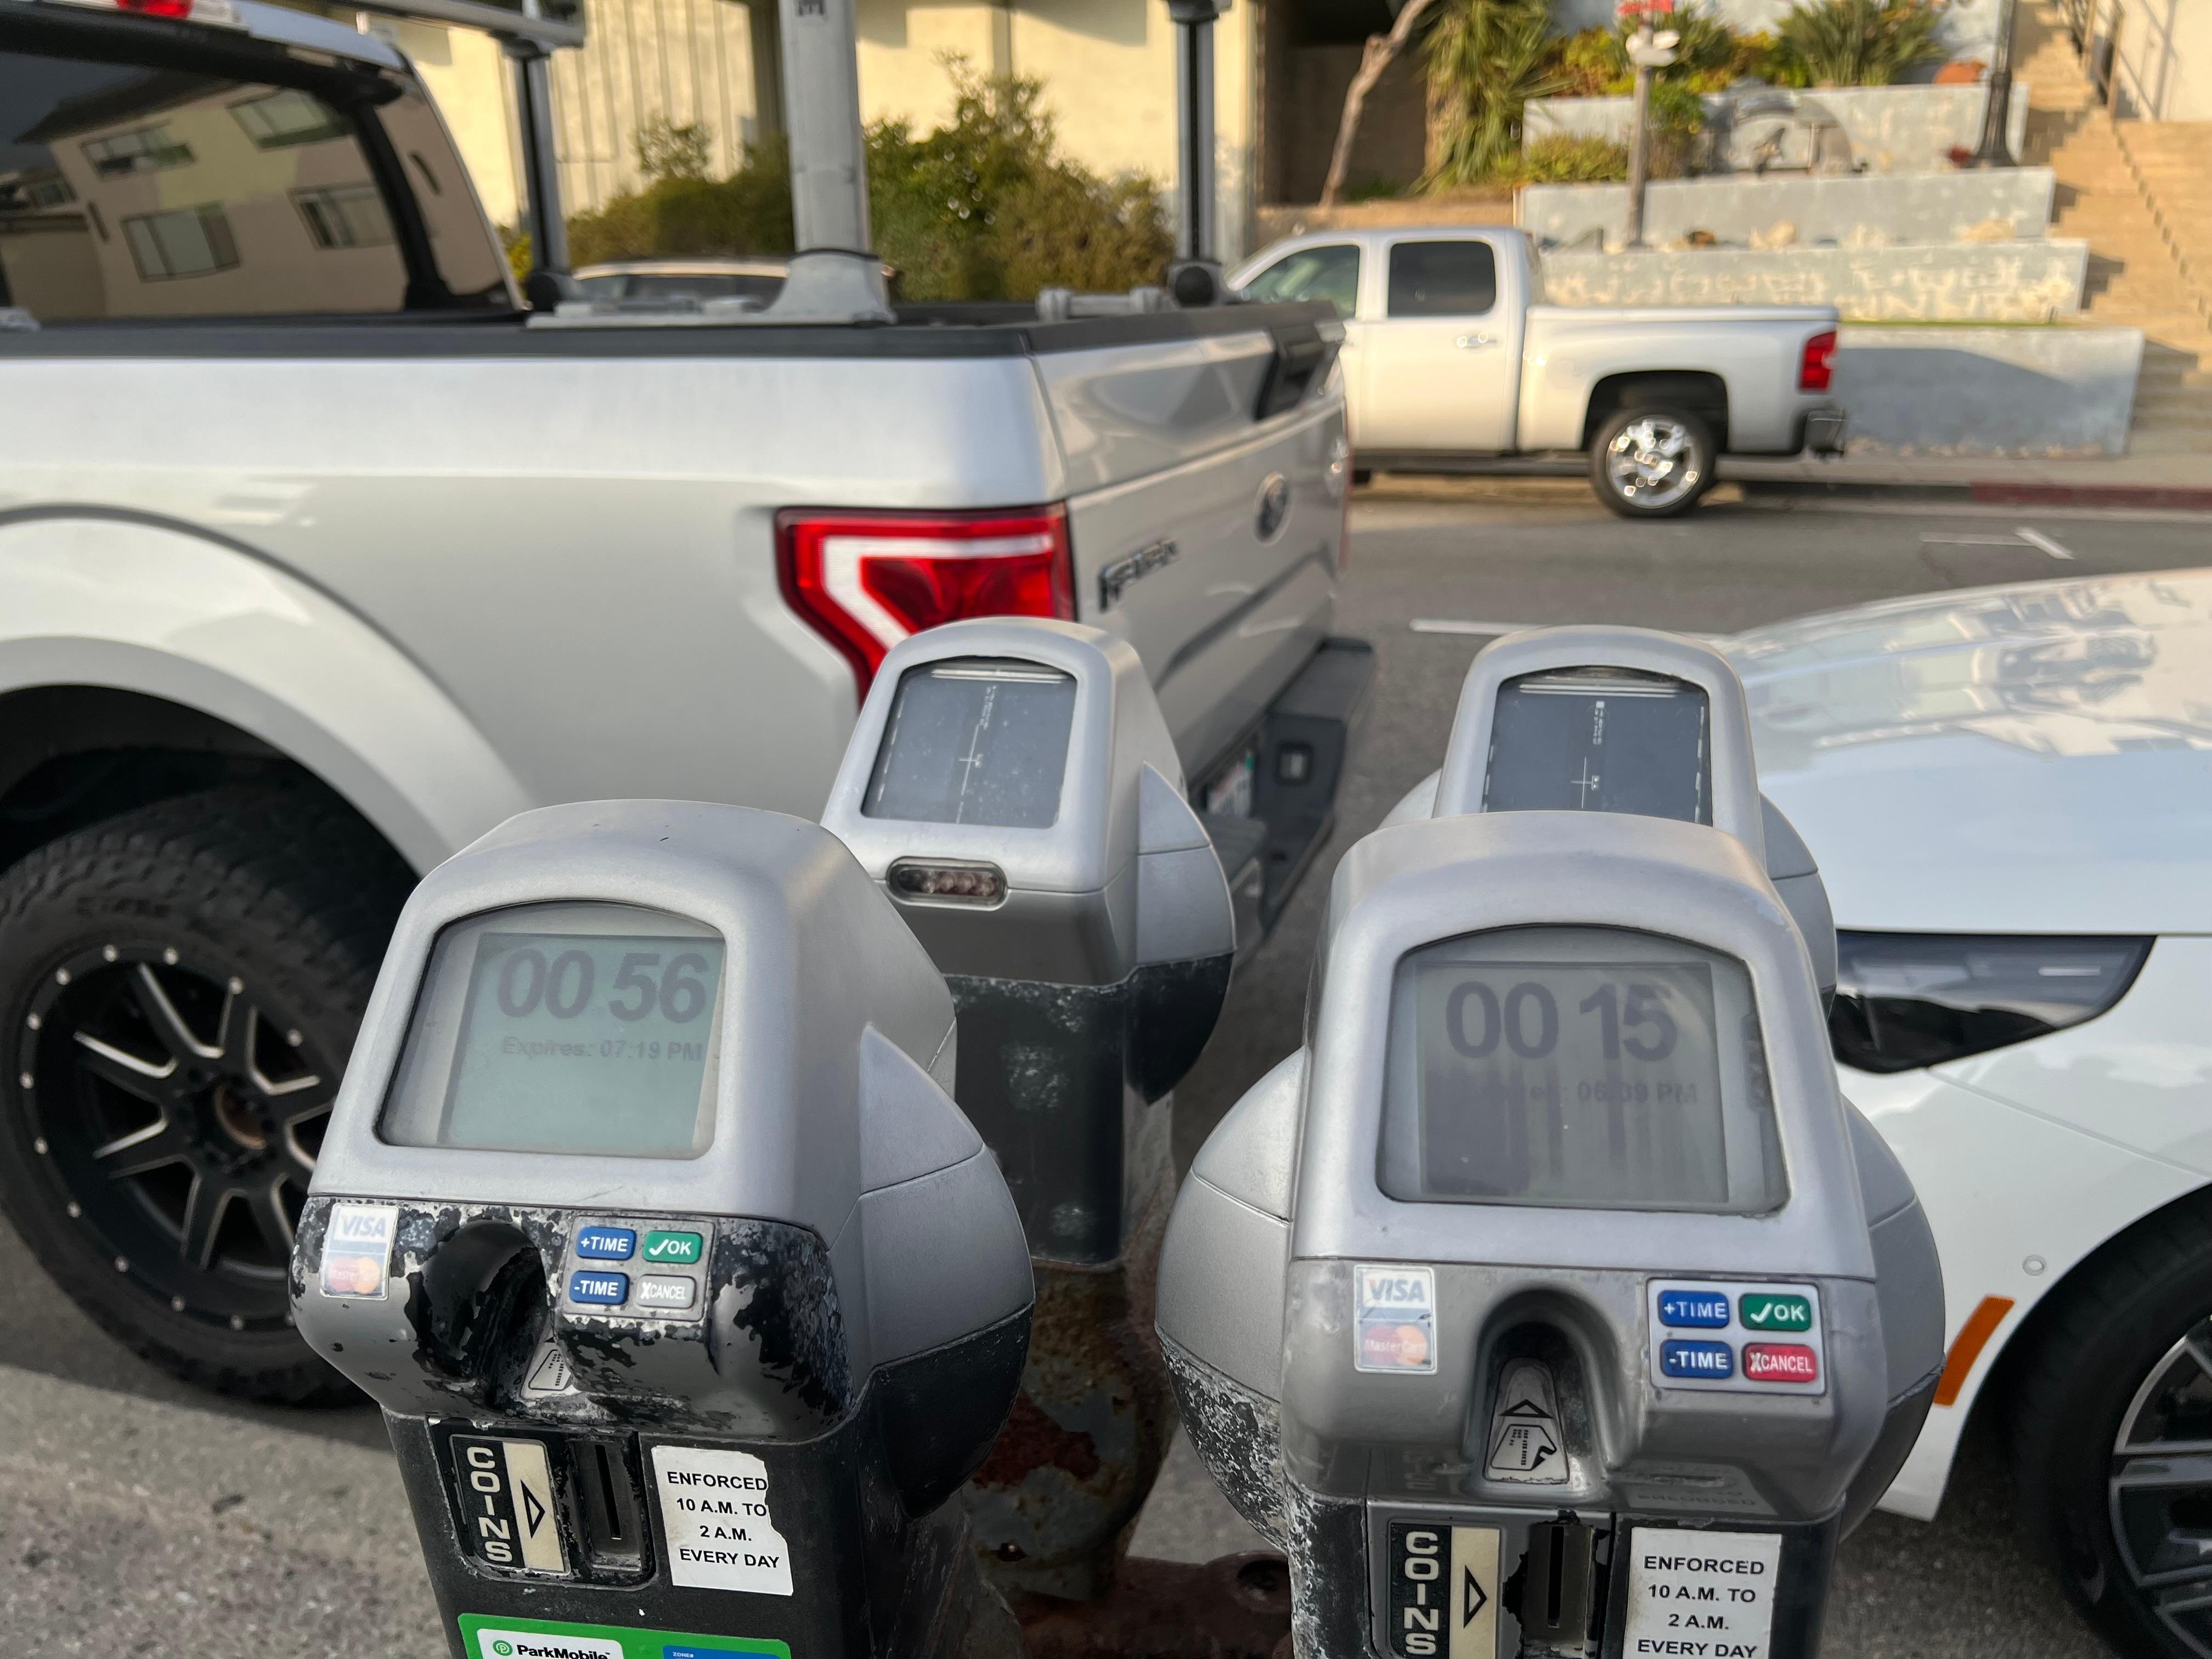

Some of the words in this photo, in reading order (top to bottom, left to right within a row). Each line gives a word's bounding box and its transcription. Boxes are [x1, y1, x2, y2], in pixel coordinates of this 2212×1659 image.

[496, 947, 595, 1019] 00
[608, 952, 709, 1024] 56
[1446, 981, 1559, 1059] 00
[1579, 983, 1678, 1061] 15
[667, 1042, 703, 1061] PM
[341, 1215, 386, 1237] VISA
[580, 1236, 629, 1252] +TIME
[667, 1240, 692, 1255] OK
[574, 1280, 619, 1296] -TIME
[1368, 1279, 1425, 1302] VISA
[1664, 1301, 1728, 1319] +TIME
[1773, 1304, 1805, 1322] OK
[1669, 1351, 1728, 1369] -TIME
[668, 1471, 768, 1491] ENFORCED
[467, 1446, 512, 1562] COINS
[677, 1498, 696, 1512] 10
[701, 1500, 738, 1515] A.M.
[742, 1502, 768, 1517] TO
[699, 1525, 710, 1538] 2
[714, 1527, 752, 1541] A.M.
[680, 1548, 739, 1565] EVERY
[744, 1554, 780, 1568] DAY
[1644, 1555, 1765, 1575] ENFORCED
[1403, 1531, 1440, 1656] COINS
[1649, 1584, 1671, 1599] 10
[1675, 1585, 1721, 1602] A.M.
[1727, 1588, 1756, 1604] TO
[1667, 1612, 1679, 1627] 2
[1684, 1614, 1730, 1630] A.M.
[1638, 1639, 1708, 1656] EVERY
[1714, 1644, 1757, 1658] DAY
